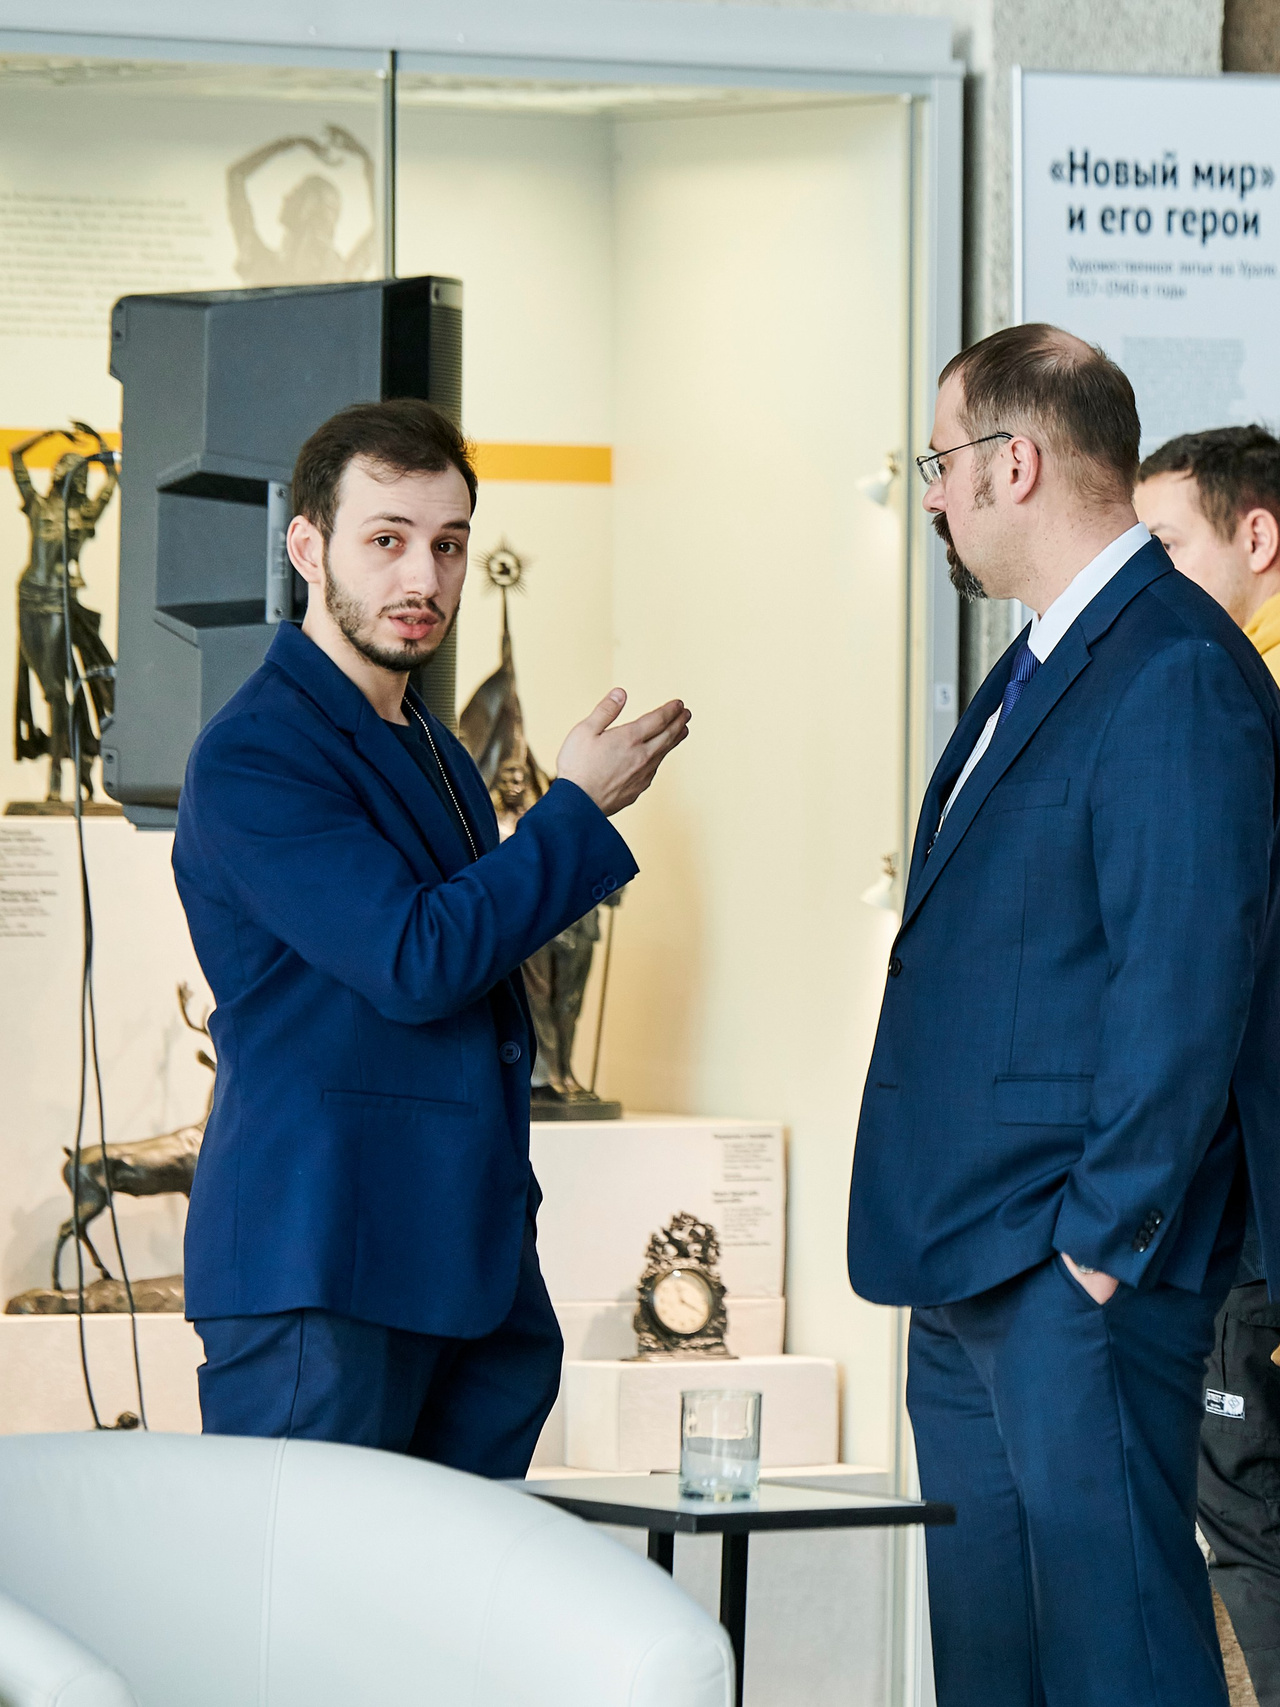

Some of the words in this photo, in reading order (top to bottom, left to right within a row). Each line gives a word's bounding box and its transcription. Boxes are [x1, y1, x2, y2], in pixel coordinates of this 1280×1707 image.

[1050, 147, 1179, 189] «Новый
[1192, 162, 1276, 201] мир»
[1067, 206, 1086, 232] и
[1100, 206, 1153, 235] его
[1166, 206, 1261, 247] герои
